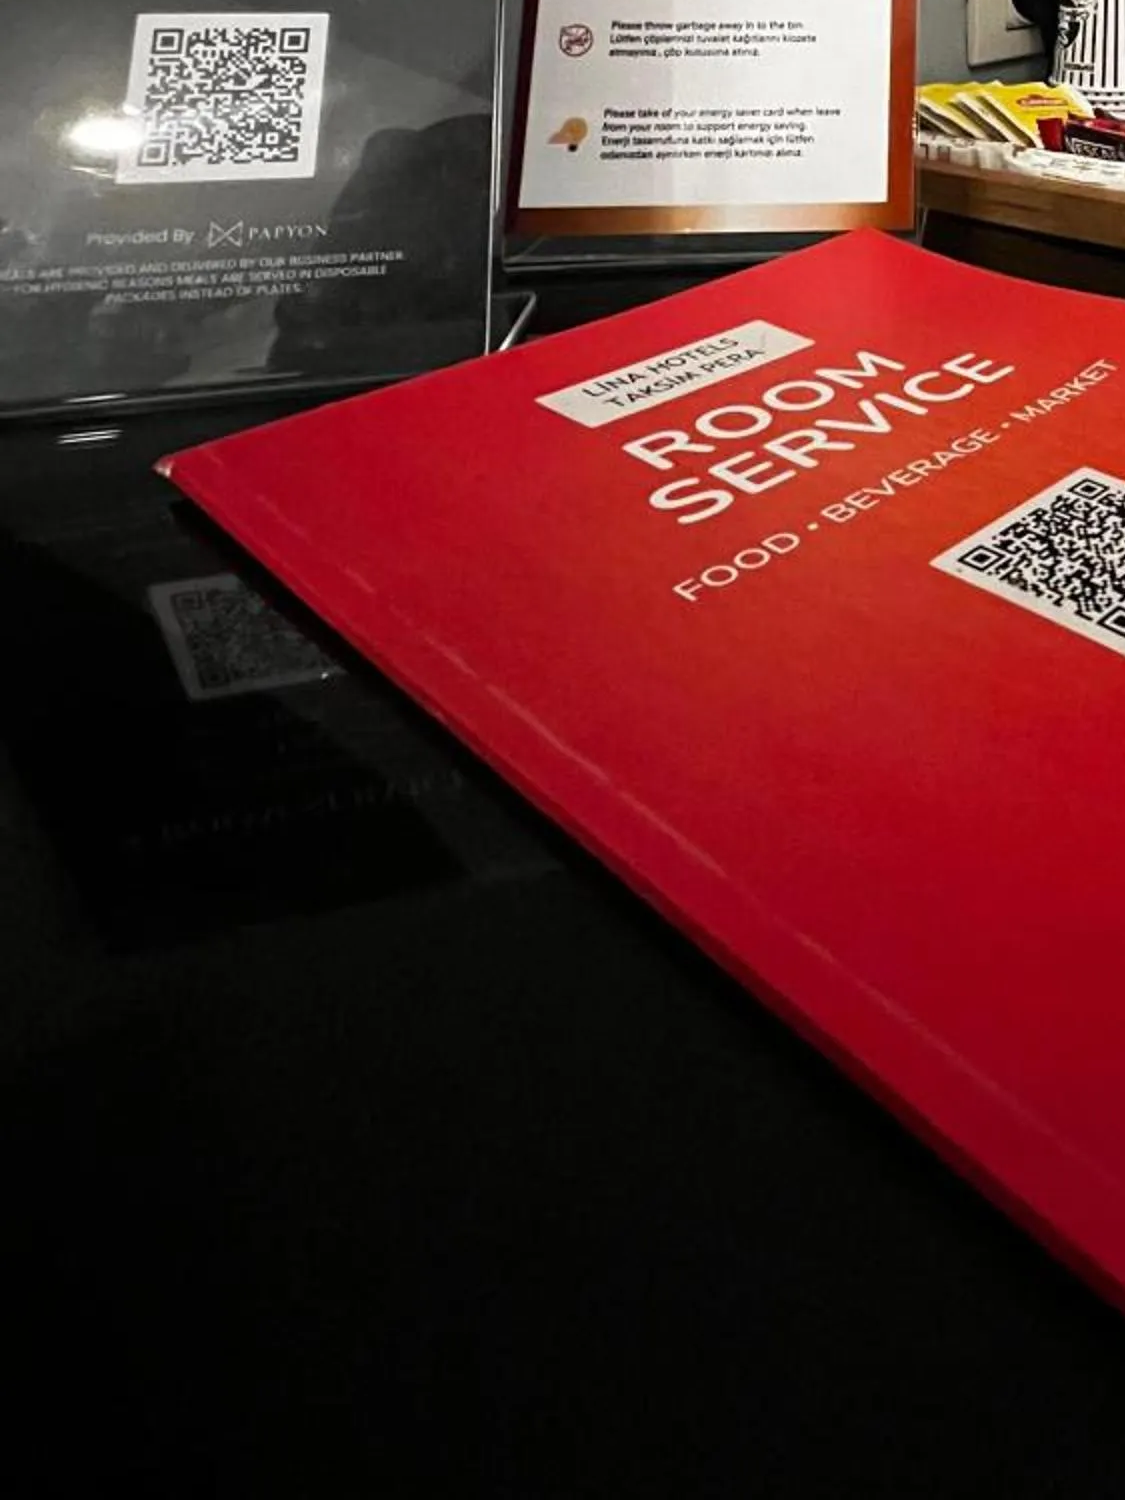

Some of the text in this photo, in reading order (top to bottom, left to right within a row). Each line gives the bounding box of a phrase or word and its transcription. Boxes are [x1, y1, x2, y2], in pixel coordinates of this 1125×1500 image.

[611, 20, 643, 31] Please
[644, 20, 674, 31] throw
[675, 20, 717, 34] garbage
[718, 22, 743, 34] away
[745, 20, 755, 31] in
[769, 20, 786, 30] the
[609, 33, 642, 45] Lütfen
[696, 33, 731, 44] tuvalet
[603, 107, 636, 118] Please
[637, 108, 659, 118] take
[661, 107, 673, 118] of
[674, 109, 698, 120] your
[699, 109, 733, 120] energy
[763, 107, 785, 117] card
[786, 107, 813, 117] when
[815, 106, 841, 117] leave
[628, 123, 652, 134] your
[683, 122, 695, 132] to
[696, 122, 736, 134] support
[737, 122, 772, 134] energy
[785, 134, 816, 145] lütfen
[86, 228, 195, 247] Provided By
[249, 224, 328, 241] PAPYON
[138, 261, 168, 274] AND
[314, 263, 388, 279] DISPOSABLE
[646, 336, 740, 373] HOTELS
[699, 347, 766, 374] PERA
[621, 350, 907, 471] ROOM
[648, 352, 1017, 526] SERVICE
[673, 358, 1120, 603] FOOD BEVERAGE MARKET
